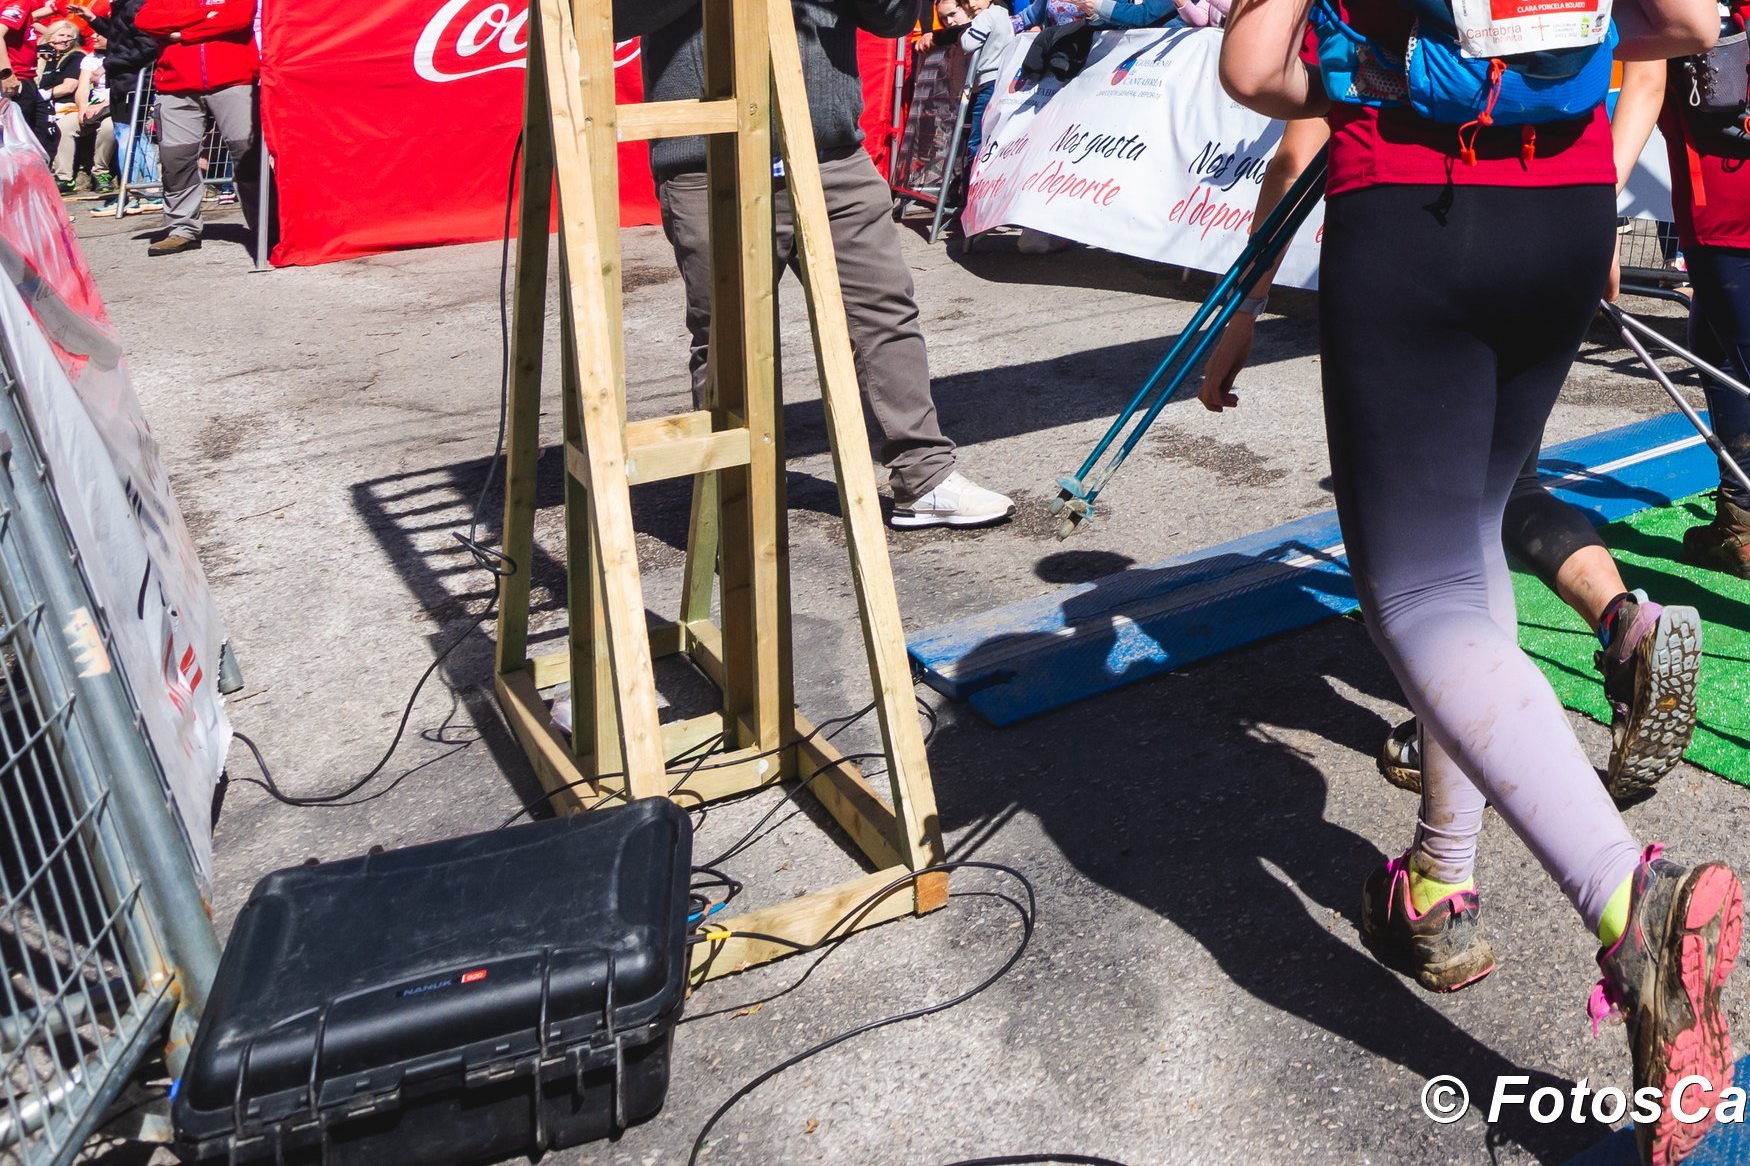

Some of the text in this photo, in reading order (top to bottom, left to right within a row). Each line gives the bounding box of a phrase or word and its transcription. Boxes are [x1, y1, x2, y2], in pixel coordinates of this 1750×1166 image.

[1517, 5, 1538, 14] CLARA
[1538, 3, 1564, 11] PONCELA
[1466, 23, 1522, 40] Cantabria
[1492, 34, 1523, 44] Infinita
[1049, 123, 1090, 154] Nos
[1071, 131, 1147, 165] gusta
[1188, 140, 1273, 193] Nos gus
[1037, 160, 1121, 207] deporte
[1168, 185, 1255, 242] el depor
[403, 977, 452, 996] NANUK
